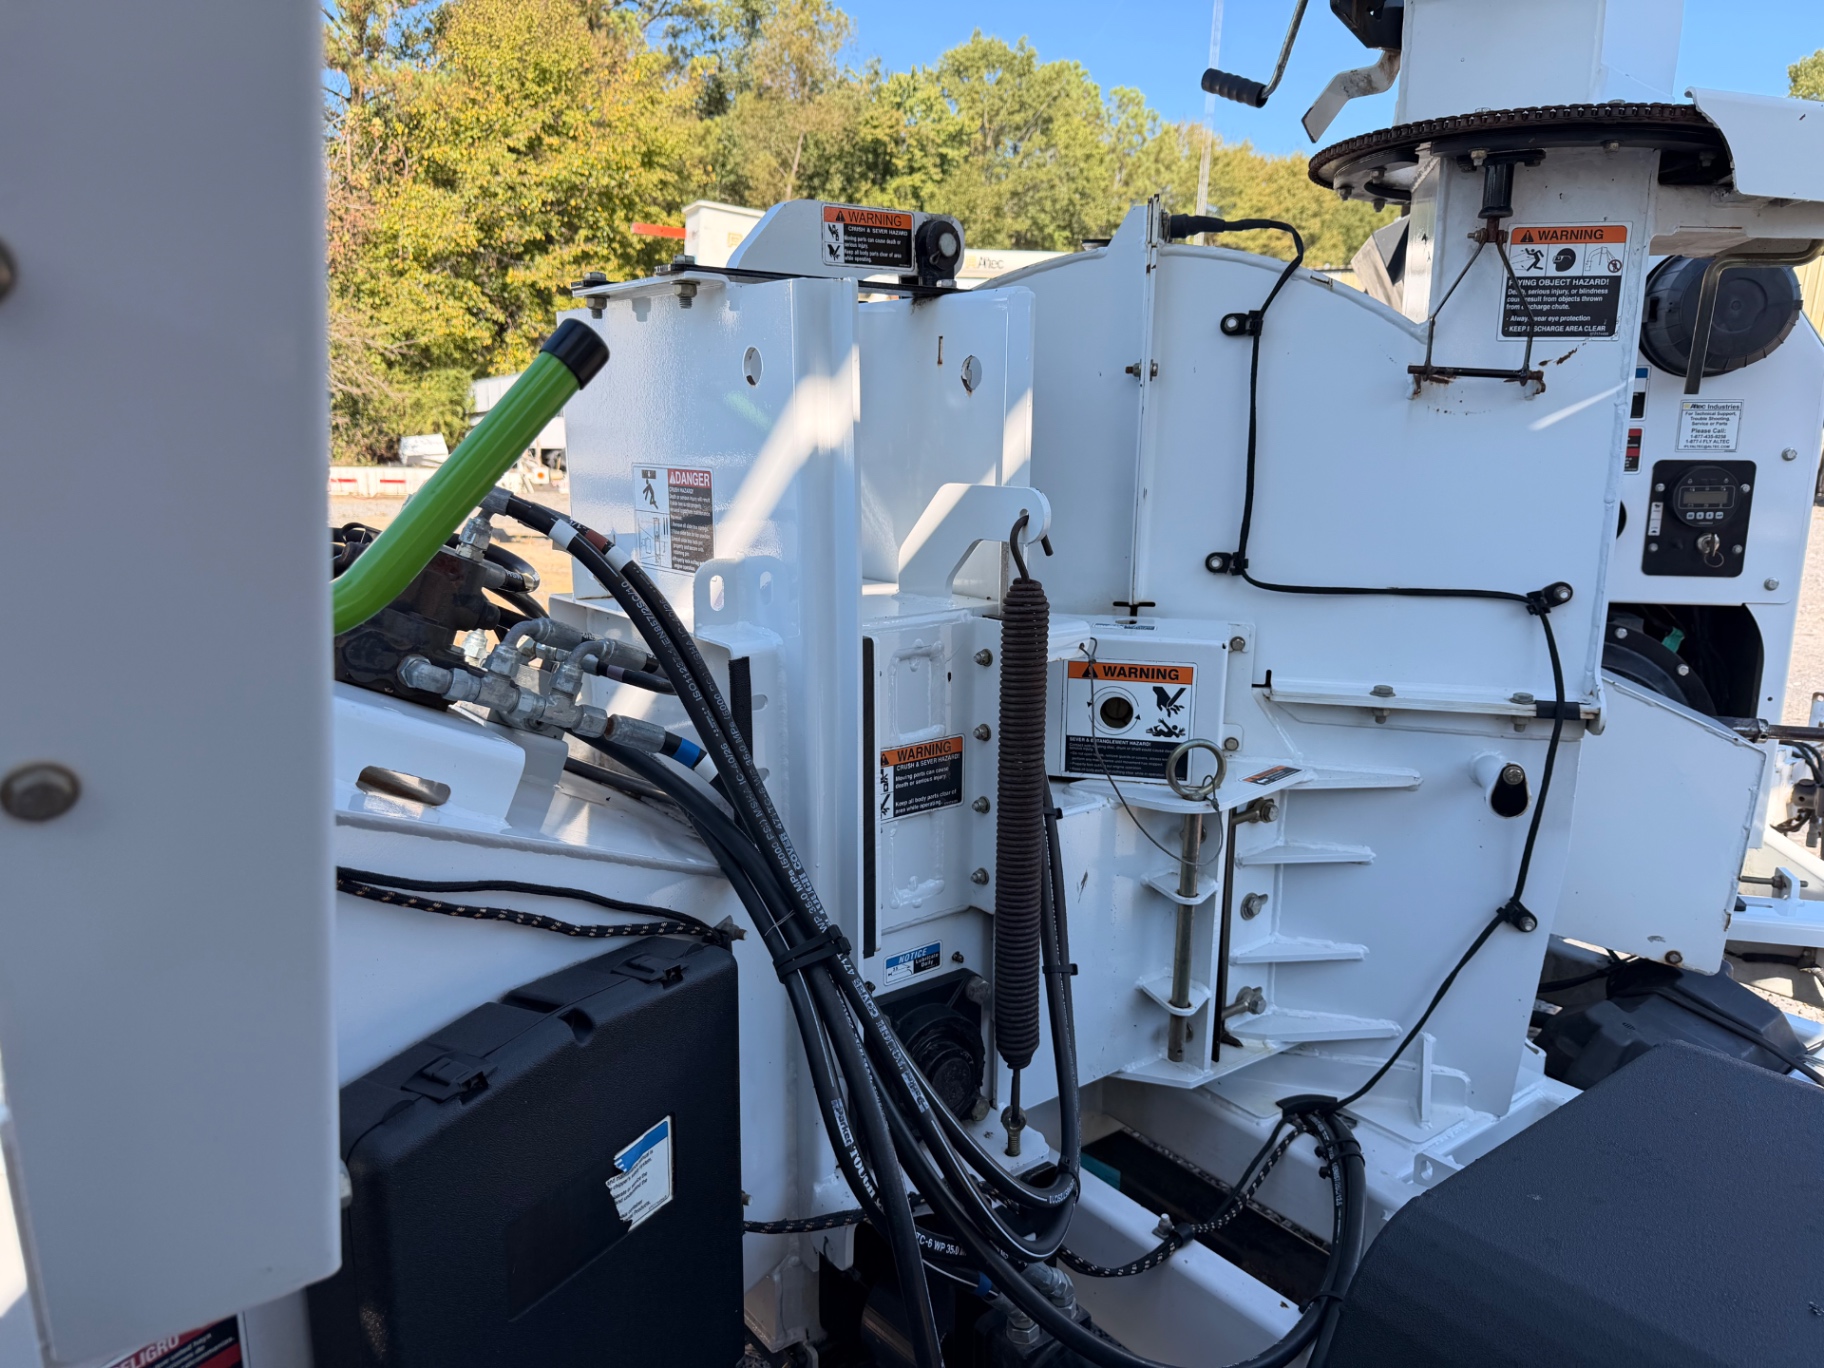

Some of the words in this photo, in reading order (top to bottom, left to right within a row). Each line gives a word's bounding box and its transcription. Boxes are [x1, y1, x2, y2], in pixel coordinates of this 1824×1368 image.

[848, 211, 902, 227] WARNING
[1538, 229, 1604, 240] WARNING
[1538, 278, 1571, 286] OBJECT
[1572, 278, 1609, 286] HAZARD!
[1551, 288, 1569, 296] injury,
[1558, 295, 1580, 303] objects
[676, 471, 710, 487] DANGER
[1103, 666, 1179, 680] WARNING
[714, 694, 730, 720] (5000
[729, 721, 744, 743] MPa
[739, 745, 753, 766] 35.0
[897, 741, 952, 762] WARNING
[720, 742, 745, 785] IC-40/26
[897, 763, 915, 771] CRUSH
[920, 758, 937, 767] SEVER
[895, 774, 912, 782] Moving
[914, 771, 925, 779] parts
[915, 777, 932, 785] serious
[771, 843, 789, 869] (5000
[778, 830, 801, 871] COVER
[788, 870, 803, 893] MPa
[800, 893, 814, 914] 35.0
[813, 917, 827, 933] WP
[837, 952, 855, 975] 471T
[899, 948, 927, 963] NOTICE
[915, 953, 939, 964] Lubricate
[852, 977, 879, 1019] COVER
[902, 1068, 929, 1112] Parker
[832, 1100, 854, 1146] Parker
[916, 1231, 933, 1247] TC-6
[934, 1240, 946, 1252] WP
[946, 1245, 959, 1255] 35.0
[112, 1334, 180, 1368] ELIGRO
